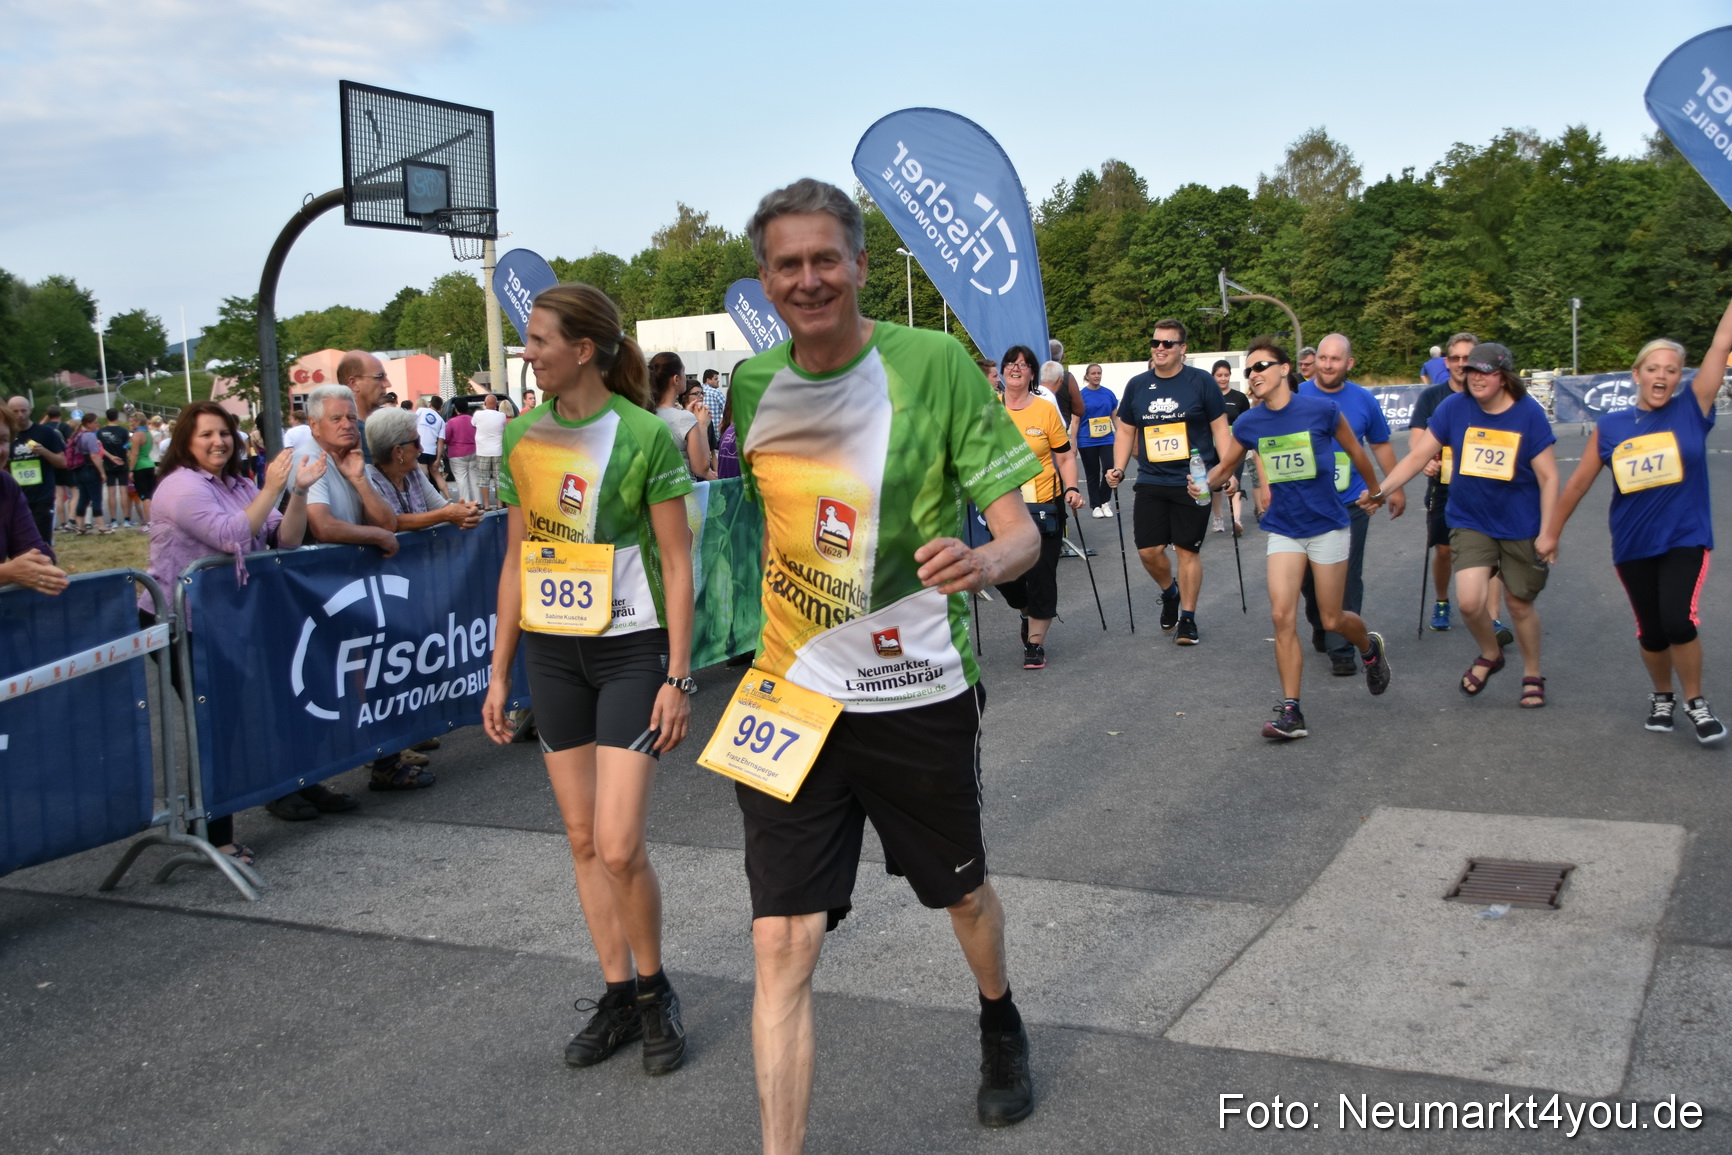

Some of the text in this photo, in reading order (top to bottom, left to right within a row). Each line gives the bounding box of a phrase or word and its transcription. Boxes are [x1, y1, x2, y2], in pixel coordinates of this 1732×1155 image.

[1600, 393, 1637, 407] Fisc
[1094, 424, 1107, 432] 720
[1155, 438, 1179, 452] 179
[1270, 452, 1305, 470] 775
[1474, 447, 1505, 466] 792
[1626, 453, 1665, 477] 747
[18, 469, 36, 479] 168
[564, 506, 577, 515] 1628
[823, 545, 842, 559] 1628
[540, 578, 593, 609] 983
[336, 612, 499, 698] Fischer
[857, 659, 930, 678] Neumarkter
[845, 667, 943, 692] Lammsbräu
[733, 715, 801, 762] 997
[726, 751, 743, 764] Franz
